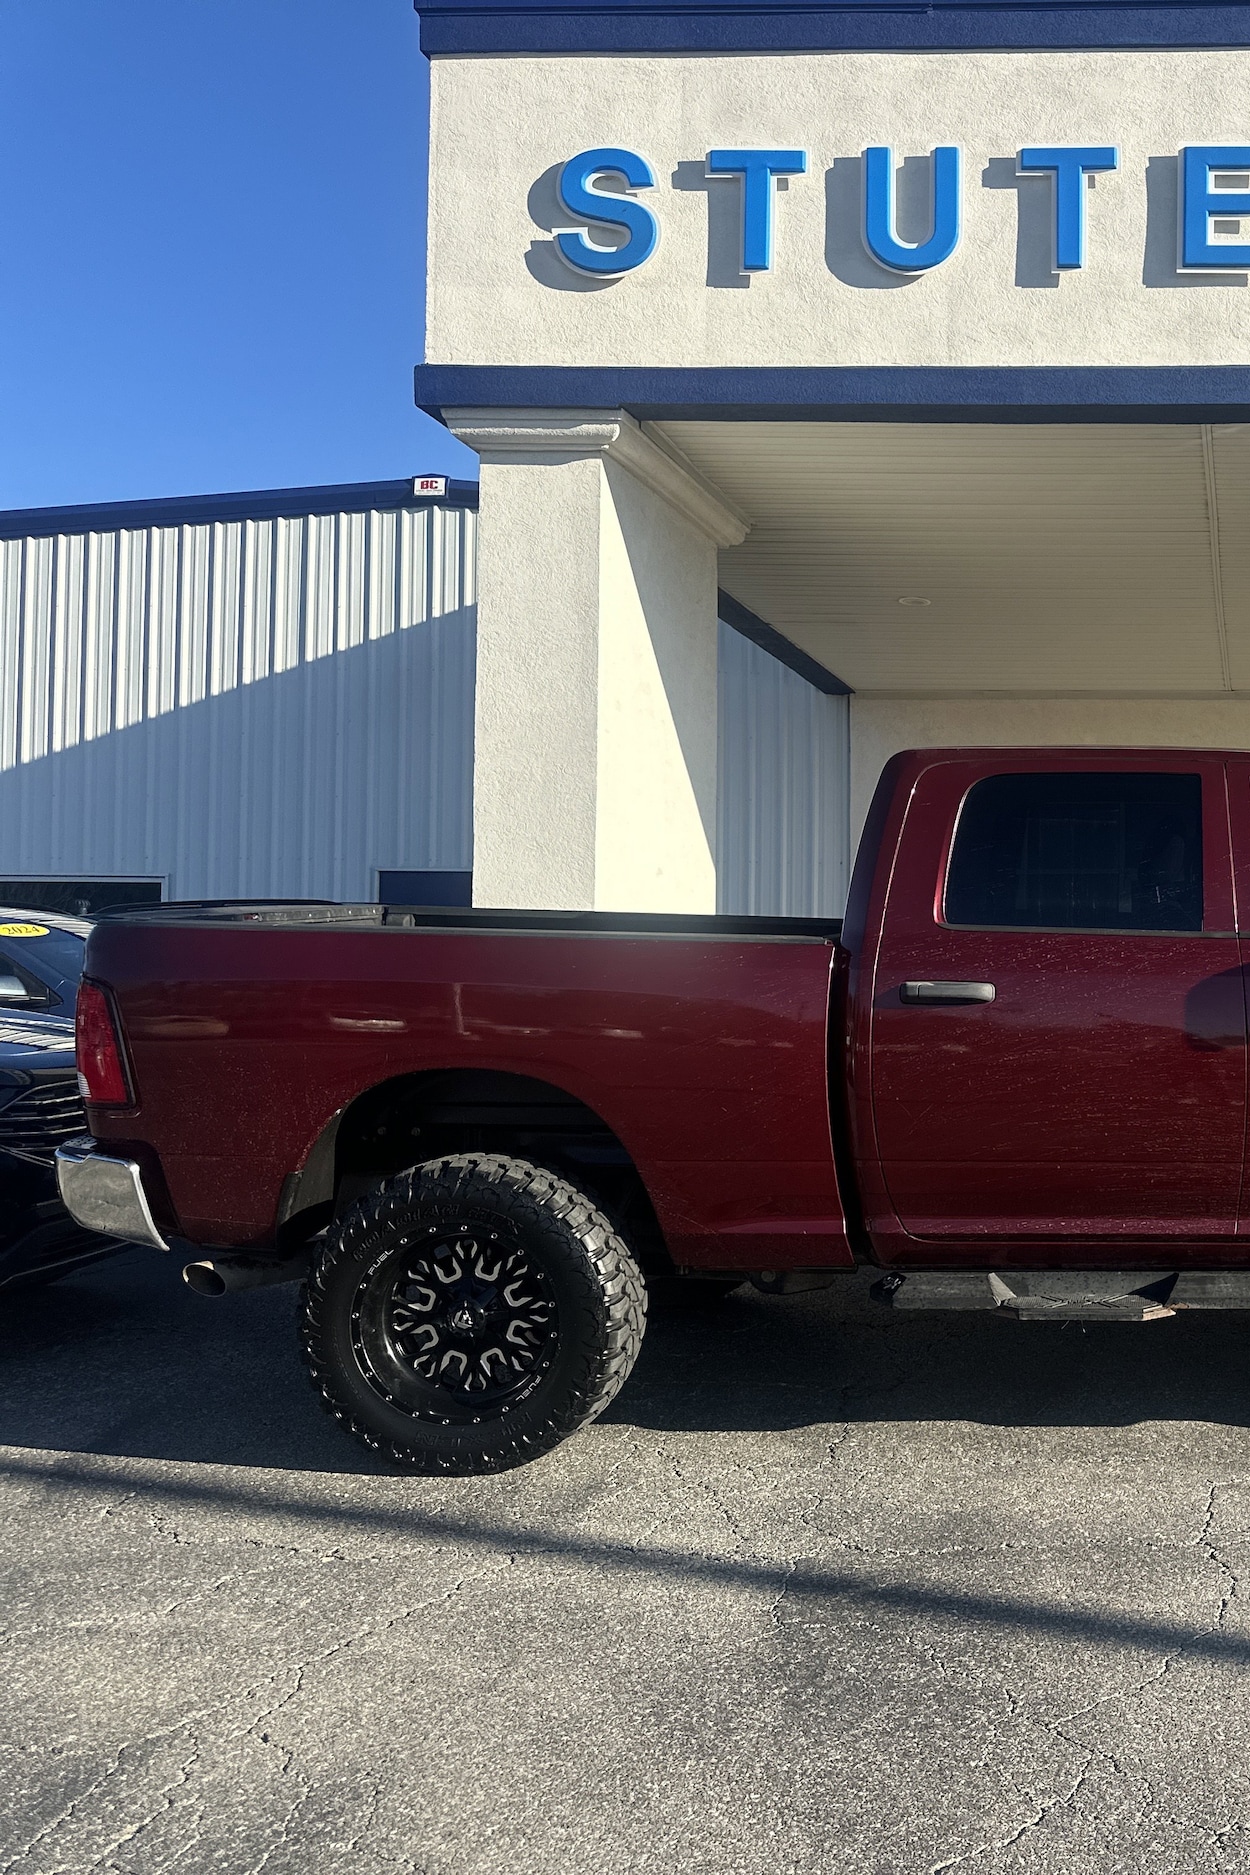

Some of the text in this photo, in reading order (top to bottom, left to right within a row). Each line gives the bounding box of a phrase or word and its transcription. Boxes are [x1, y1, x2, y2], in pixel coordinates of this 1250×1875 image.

[2, 926, 40, 935] 2024
[367, 1249, 395, 1276] FUEL
[515, 1374, 543, 1401] FUEL
